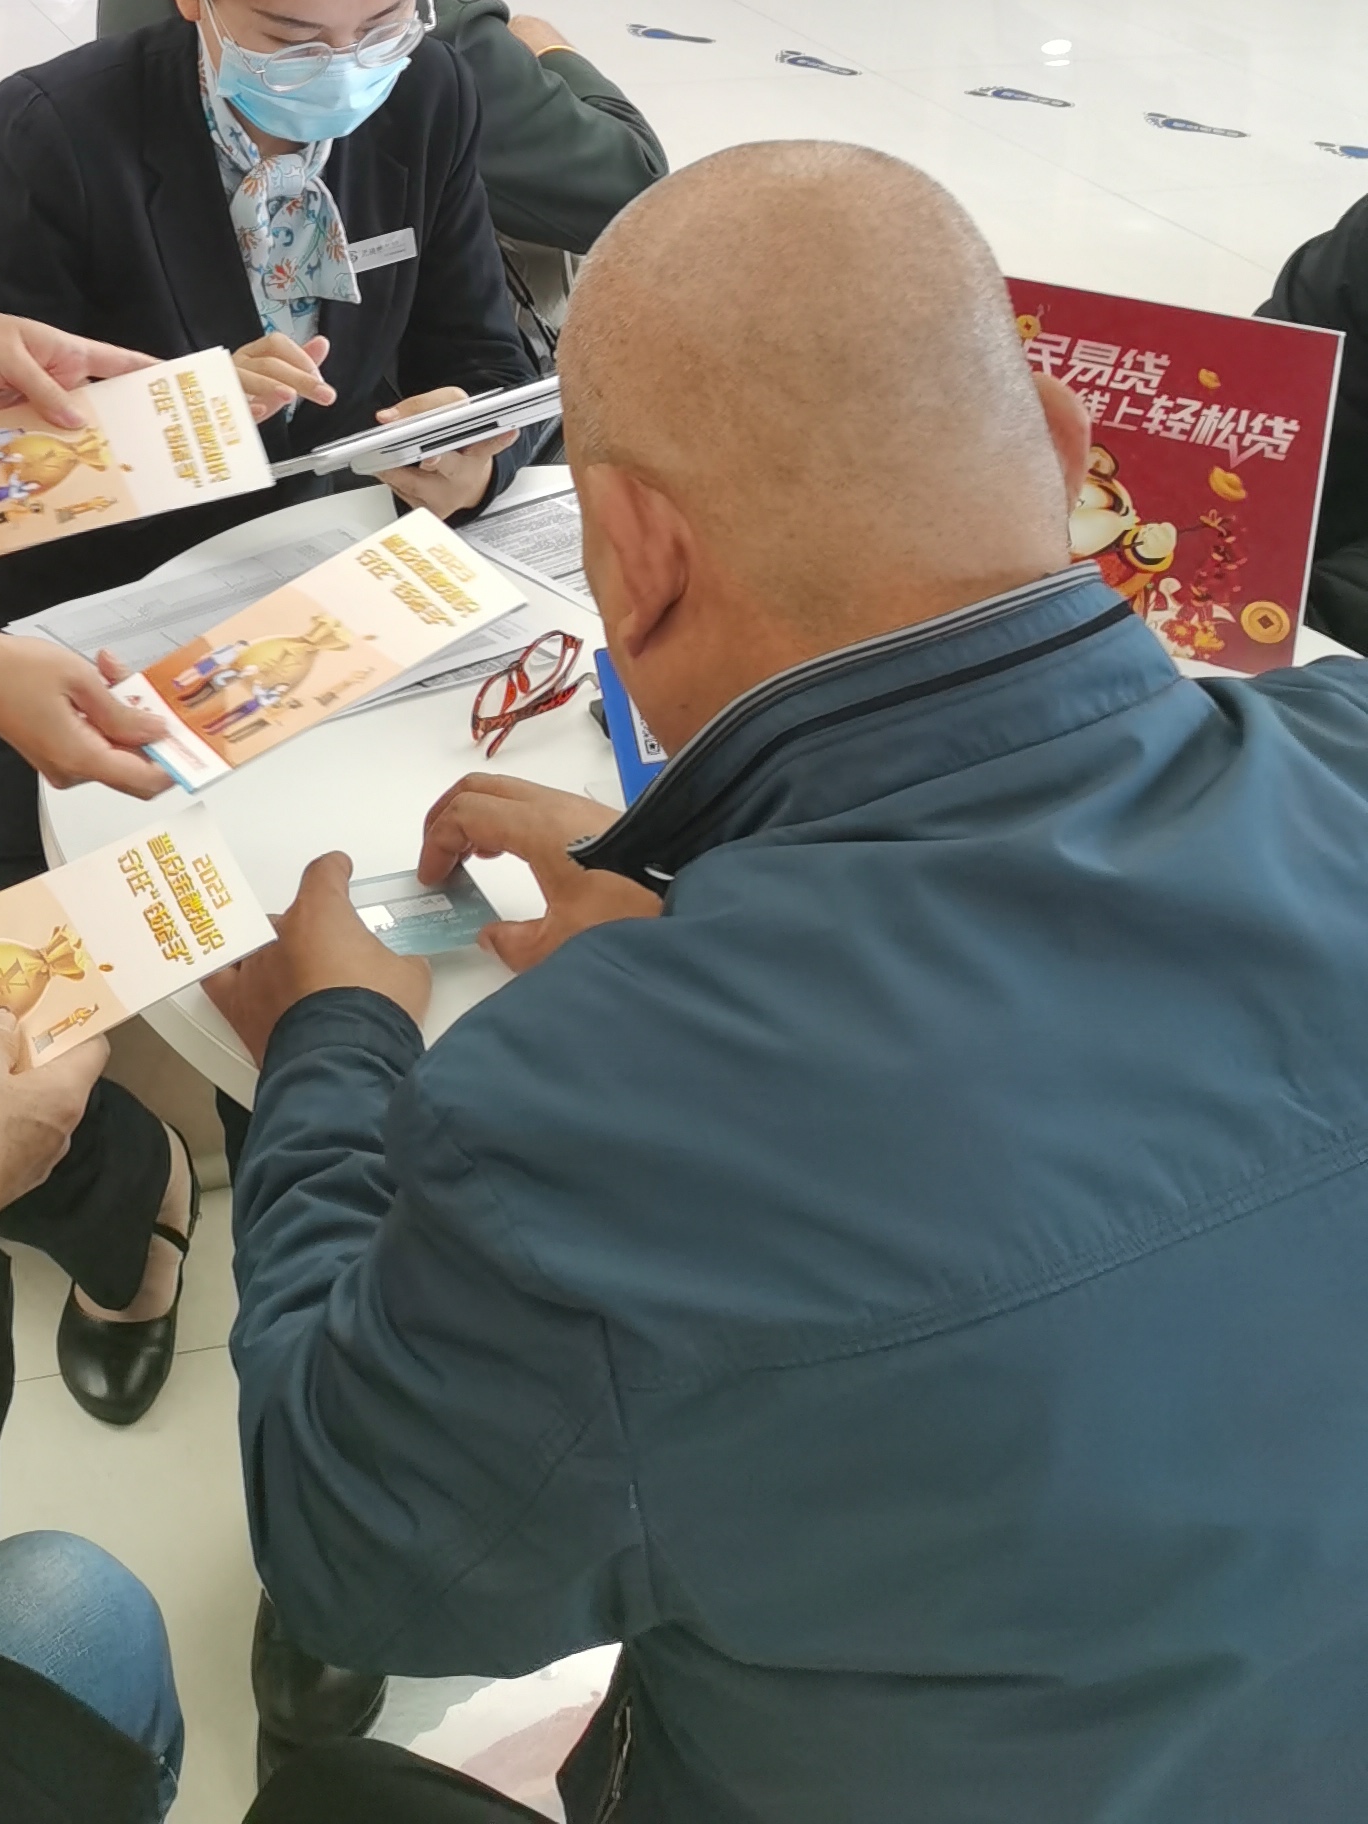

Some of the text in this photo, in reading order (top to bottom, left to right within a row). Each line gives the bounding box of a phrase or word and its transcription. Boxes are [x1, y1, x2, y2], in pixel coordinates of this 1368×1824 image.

[147, 831, 225, 956] 普及金融知识
[192, 853, 233, 911] 2023
